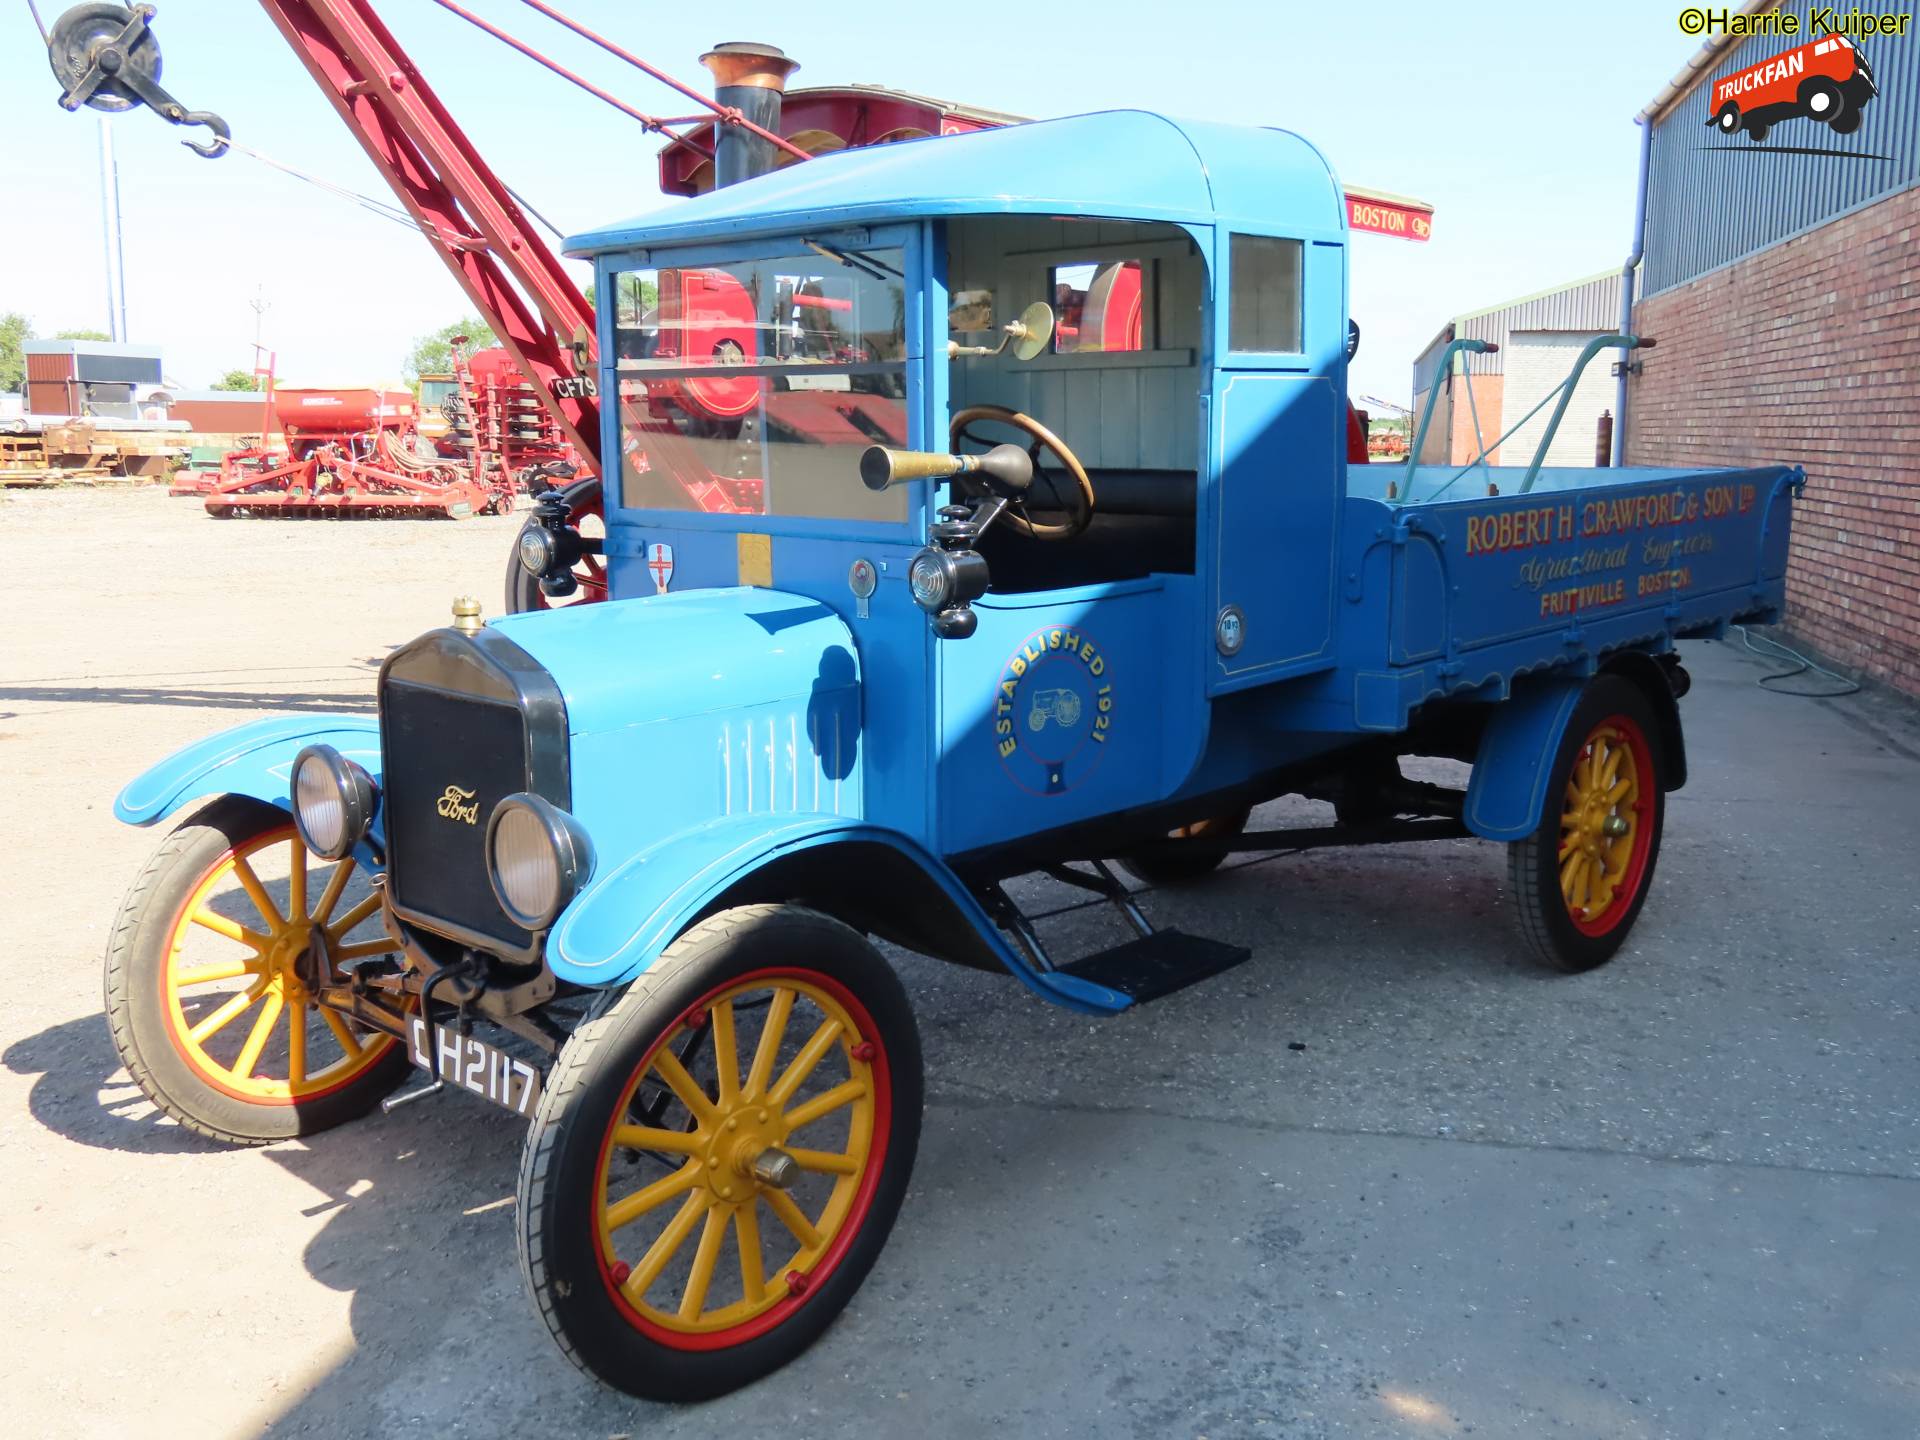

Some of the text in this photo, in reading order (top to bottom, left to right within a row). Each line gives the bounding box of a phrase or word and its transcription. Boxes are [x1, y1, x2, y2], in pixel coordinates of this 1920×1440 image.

[1352, 204, 1406, 232] BOSTON
[1466, 507, 1555, 557] ROBERT
[1582, 491, 1686, 538] CRAWFORD
[1703, 484, 1734, 519] SON
[996, 630, 1112, 758] ESTABLISHED 1921
[436, 784, 479, 826] Ford
